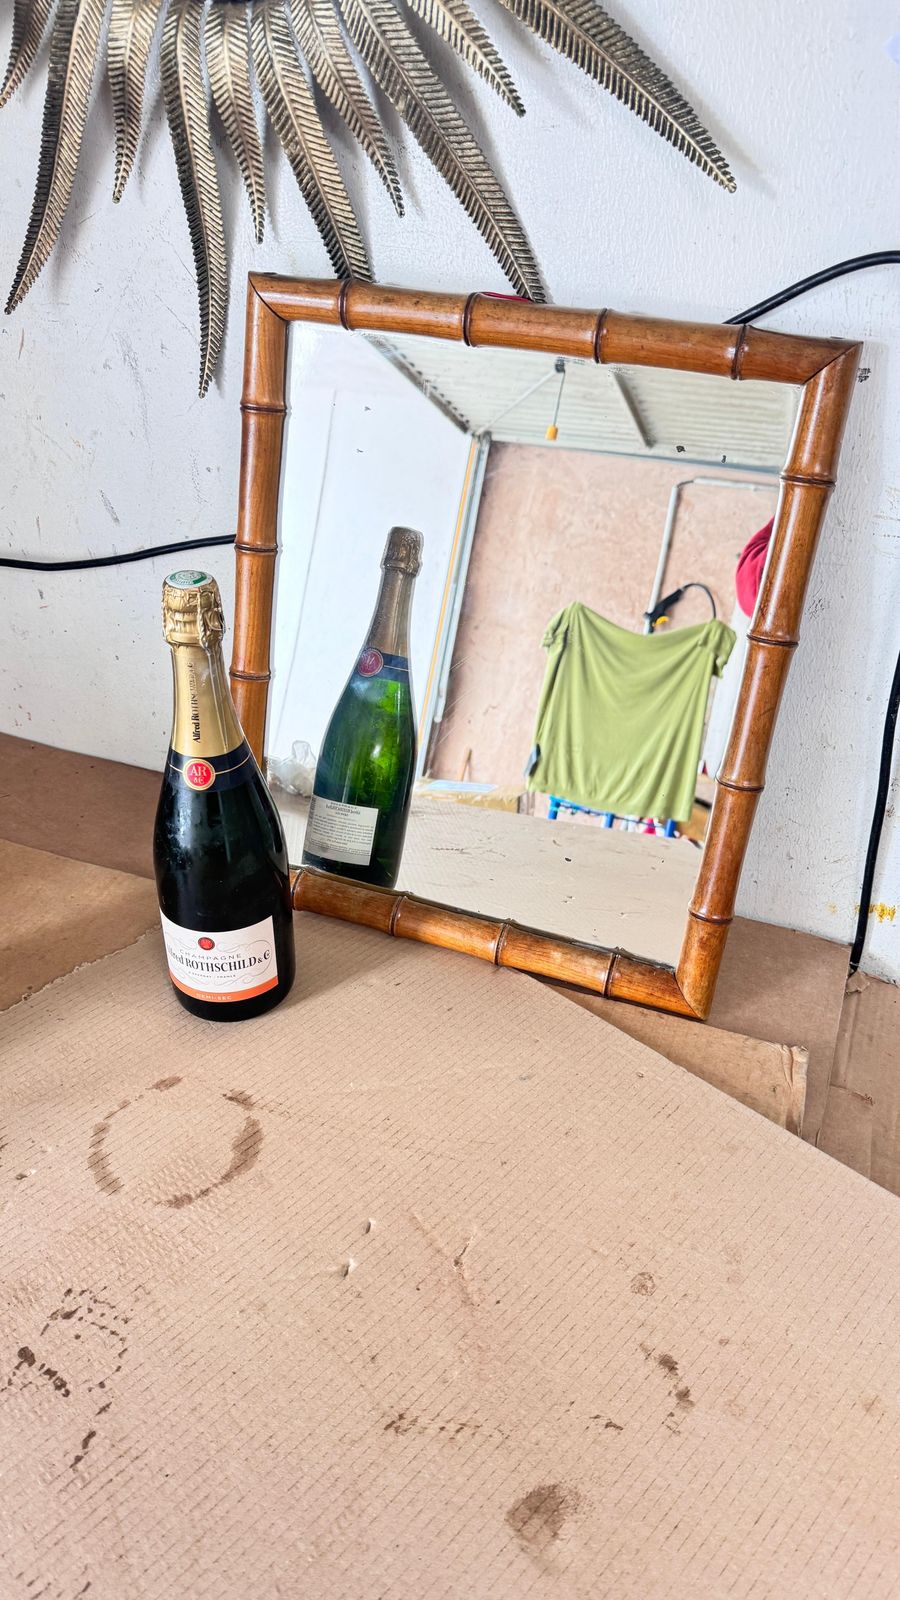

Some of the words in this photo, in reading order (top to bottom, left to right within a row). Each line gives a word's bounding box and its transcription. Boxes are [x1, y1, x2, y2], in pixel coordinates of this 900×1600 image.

[192, 722, 201, 744] Alfred
[190, 765, 207, 776] AR
[180, 949, 241, 960] CHAMPAGNE
[185, 956, 257, 972] ROTHSCHILD
